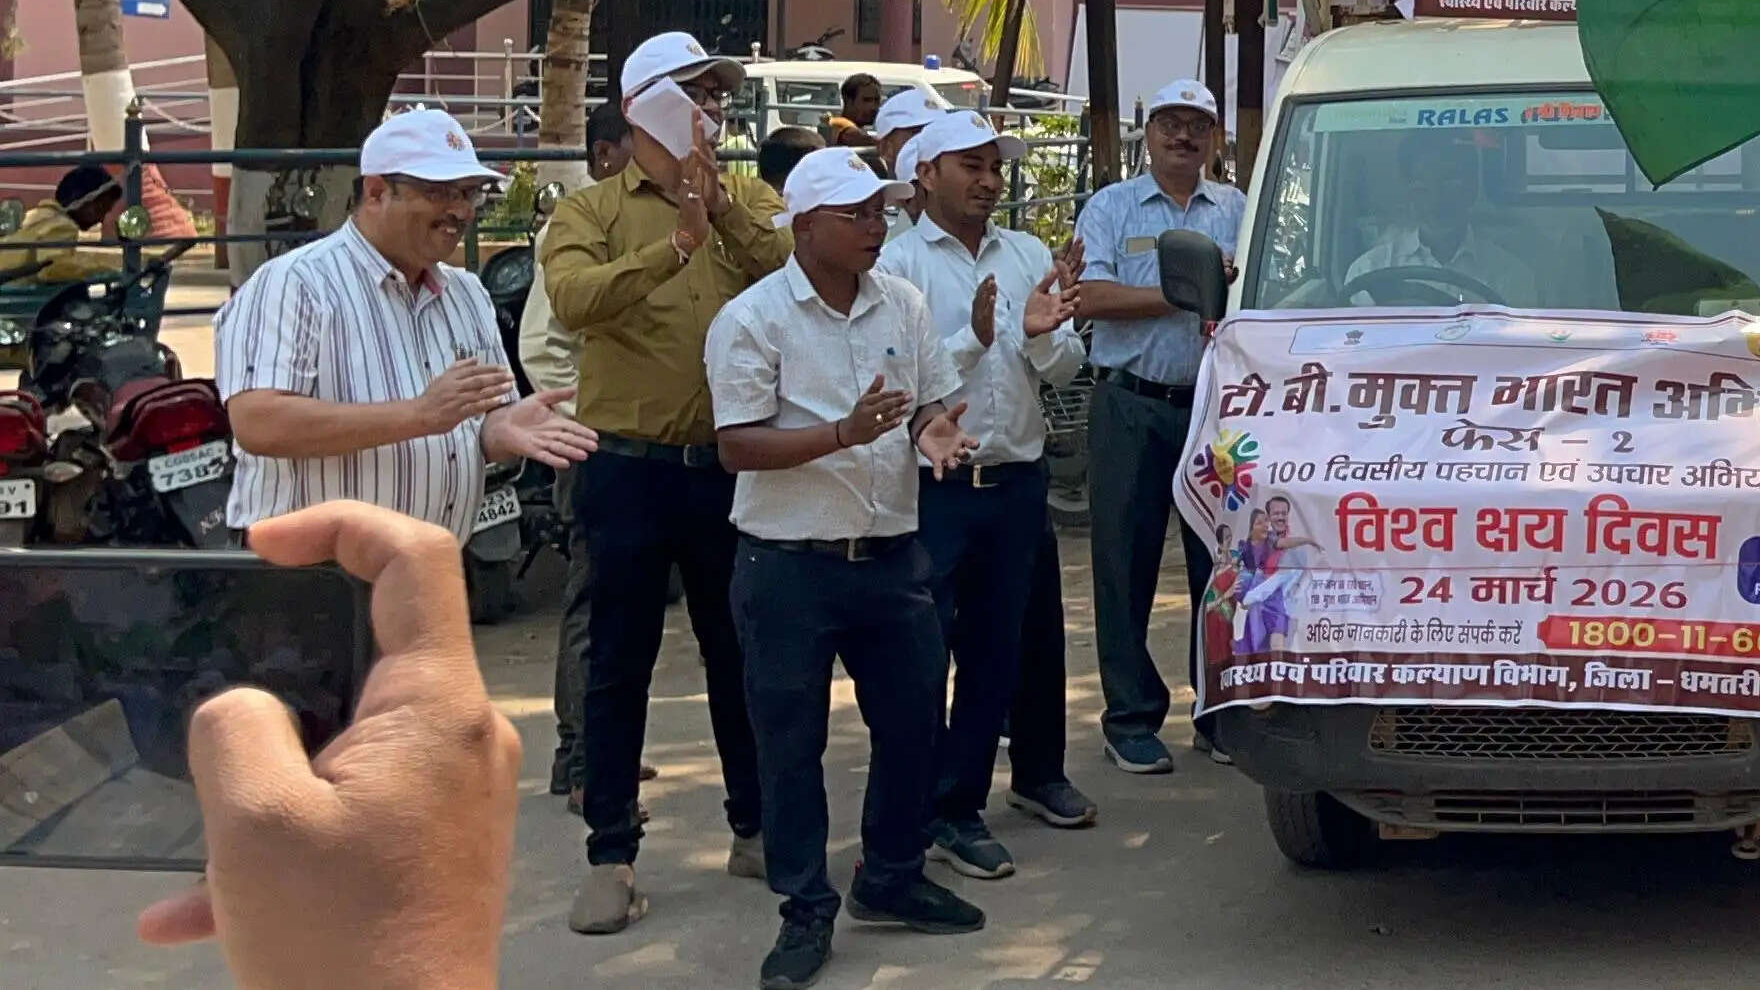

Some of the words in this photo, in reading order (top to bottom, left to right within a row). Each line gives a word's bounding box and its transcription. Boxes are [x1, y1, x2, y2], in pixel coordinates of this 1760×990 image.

[1416, 107, 1510, 126] RALAS
[1491, 371, 1638, 419] भारत
[1441, 418, 1545, 451] फेस
[1612, 431, 1634, 453] 2
[1267, 461, 1315, 484] 100
[1324, 454, 1425, 483] दिवसीय
[1436, 461, 1530, 483] पहचान
[1539, 458, 1579, 484] एवं
[1586, 462, 1673, 486] उपचार
[1335, 491, 1457, 552] विश्व
[1476, 508, 1568, 554] क्षय
[1584, 493, 1722, 560] दिवस
[1400, 576, 1453, 604] 24
[1470, 565, 1558, 604] मार्च
[1570, 578, 1688, 609] 2026
[1306, 618, 1345, 643] अधिक
[1347, 618, 1408, 644] जानकारी
[1410, 619, 1425, 643] के
[1426, 617, 1455, 645] लिए
[1457, 618, 1495, 645] संपर्क
[1498, 619, 1525, 645] करें
[1269, 657, 1311, 684] एवं
[1311, 658, 1388, 685] परिवार
[1391, 663, 1491, 687] कल्याण
[1493, 660, 1577, 692] विभाग,
[1584, 661, 1653, 690] जिला
